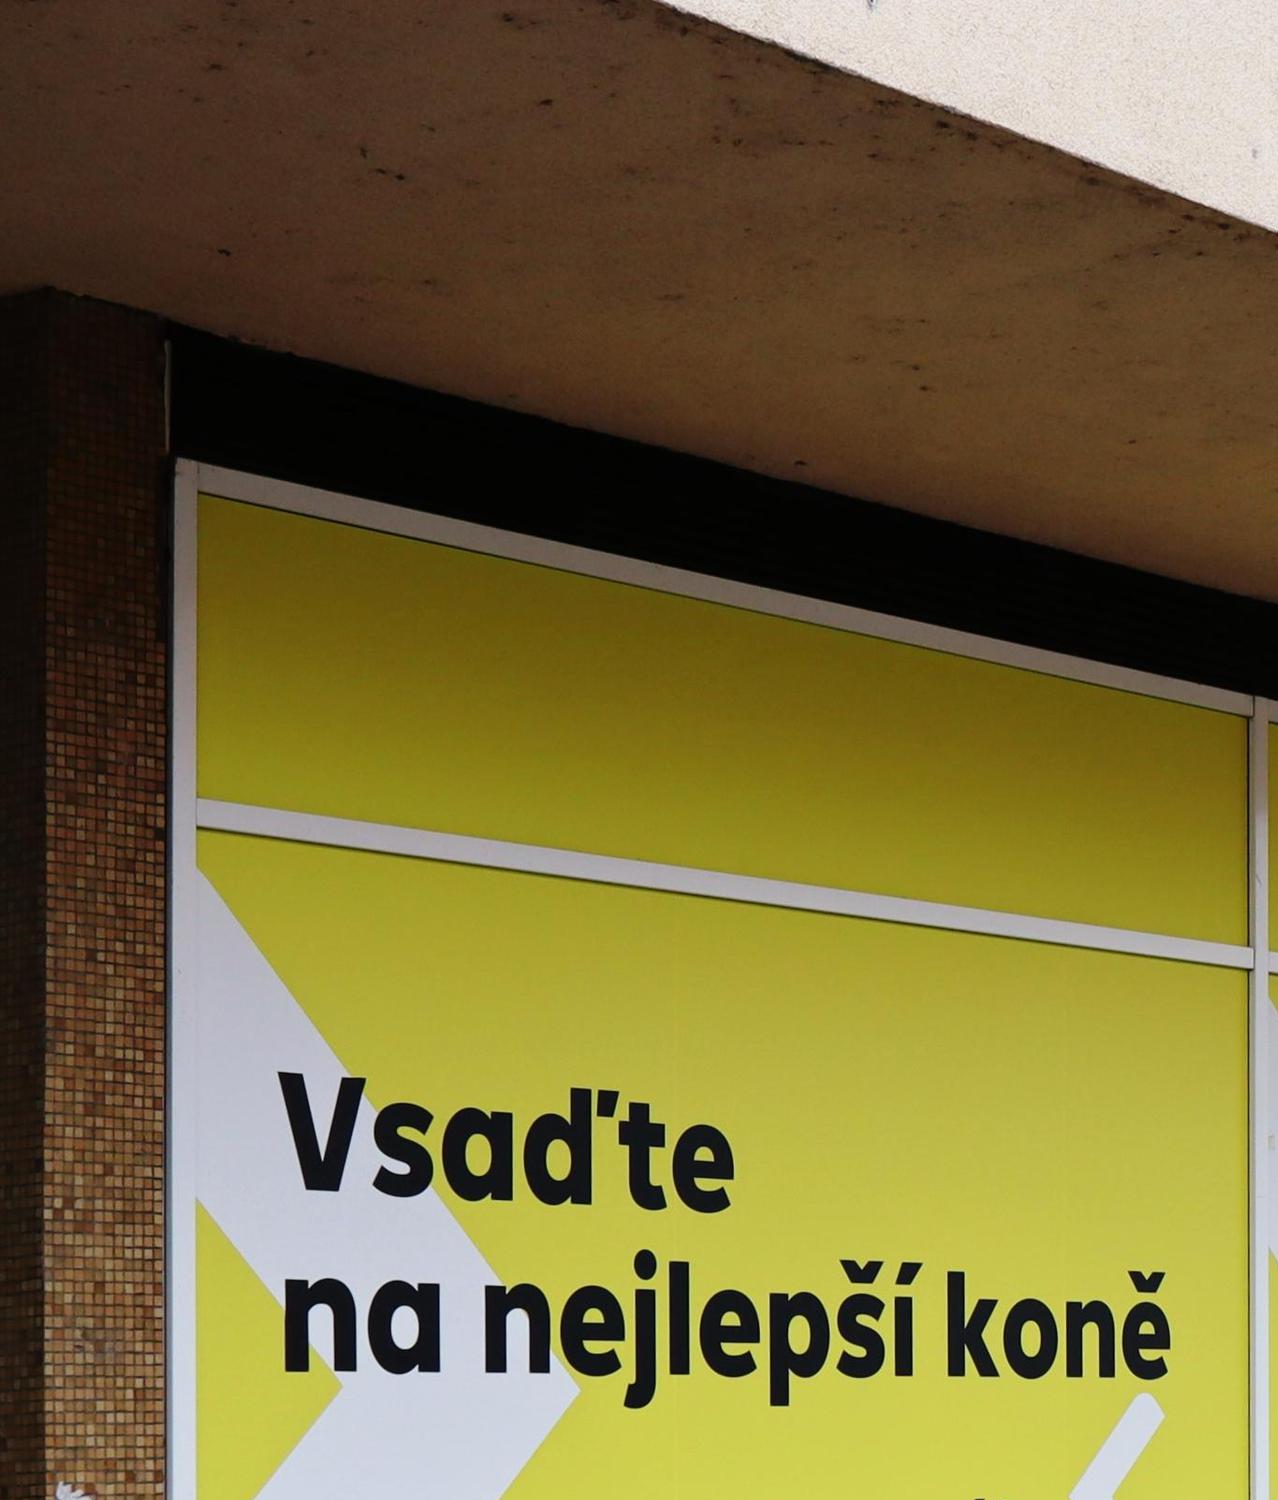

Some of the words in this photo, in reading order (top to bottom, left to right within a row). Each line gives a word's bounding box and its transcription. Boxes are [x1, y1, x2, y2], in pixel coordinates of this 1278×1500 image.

[277, 1071, 735, 1214] Vsaďte
[284, 1277, 441, 1375] na
[484, 1248, 923, 1409] nejlepší
[947, 1270, 1171, 1381] koně
